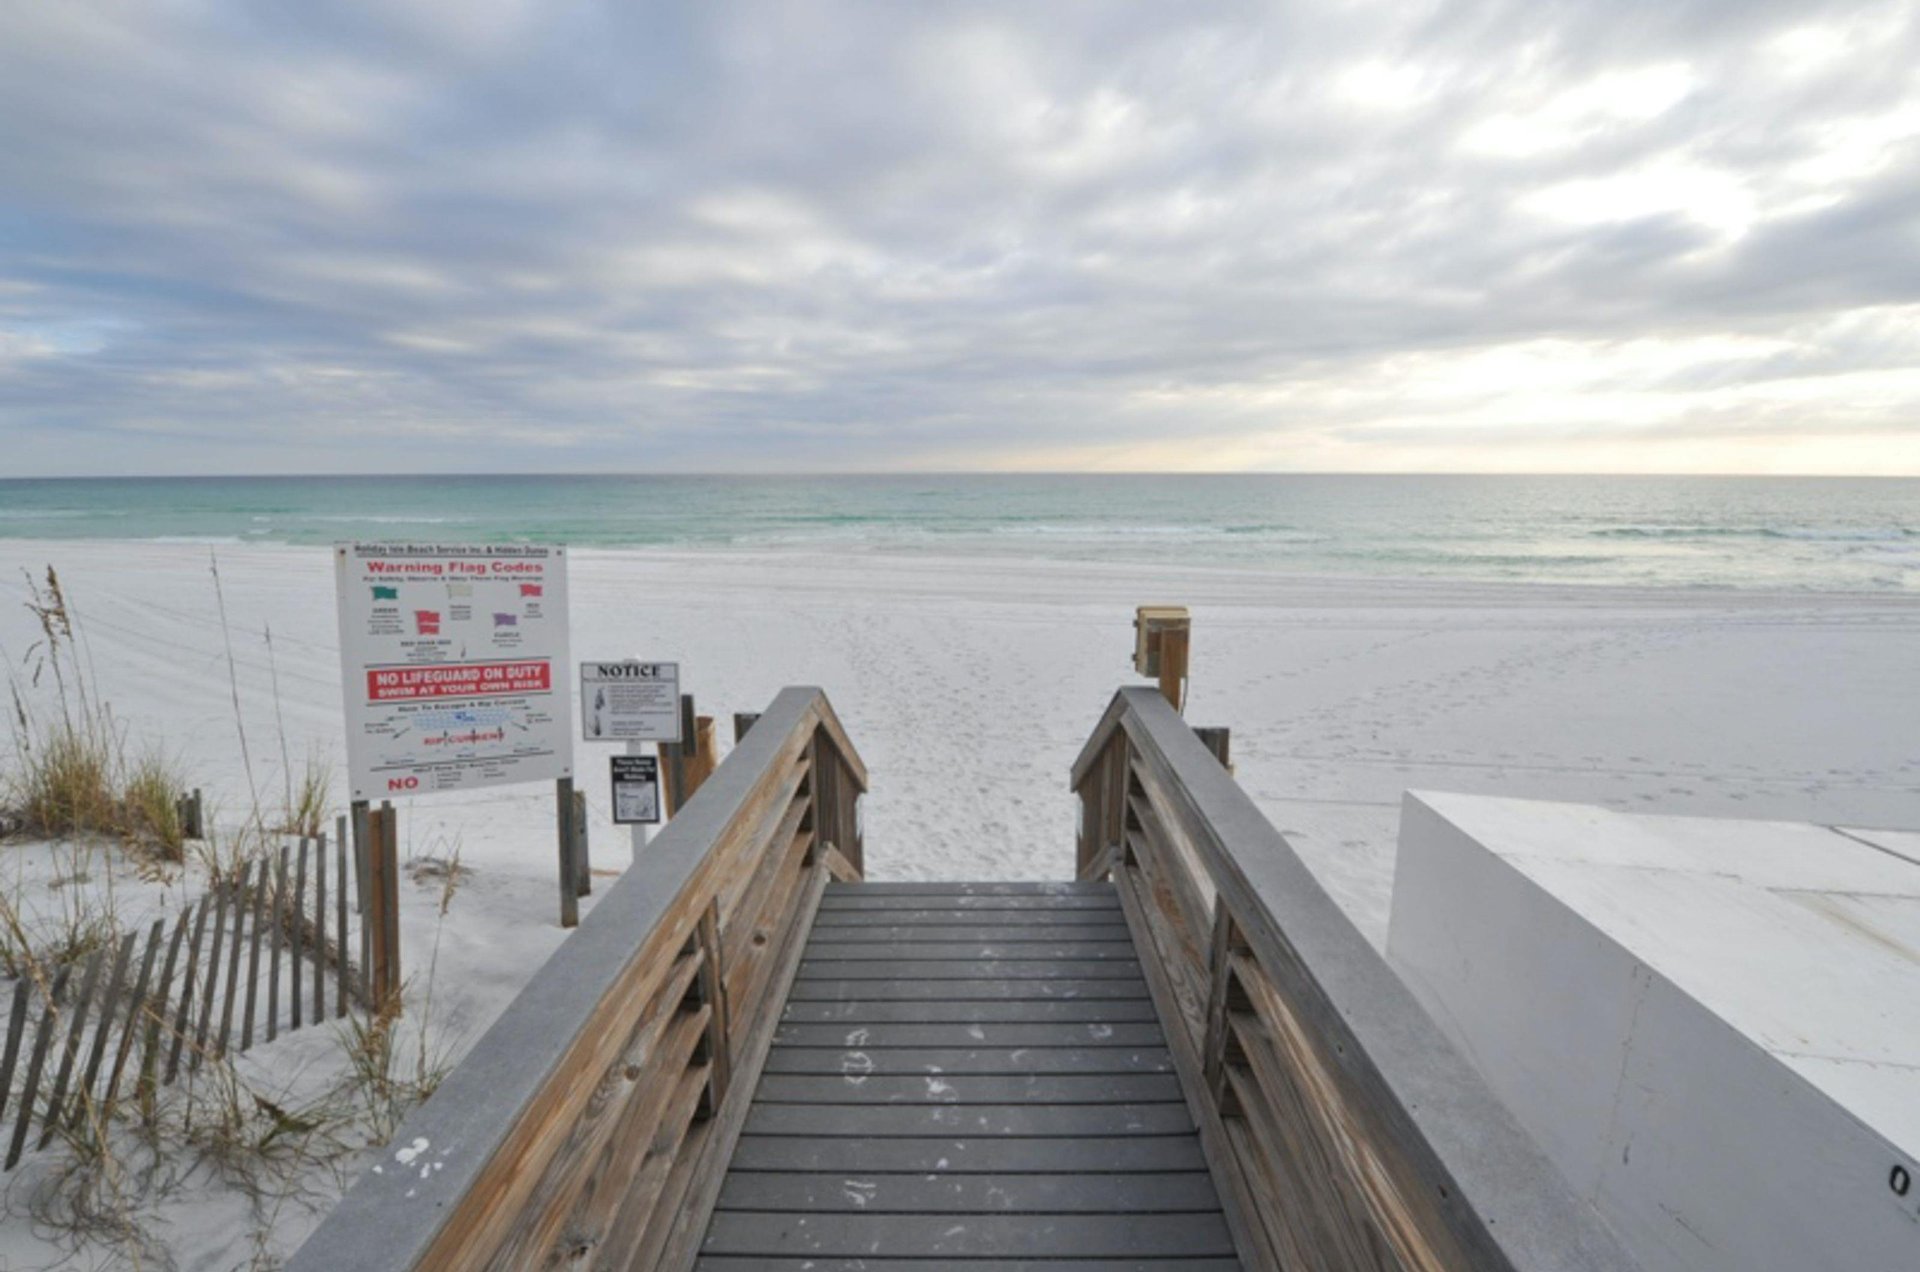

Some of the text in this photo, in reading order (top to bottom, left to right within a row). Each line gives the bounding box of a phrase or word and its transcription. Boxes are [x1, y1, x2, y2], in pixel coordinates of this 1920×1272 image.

[407, 545, 433, 553] Beach
[436, 546, 466, 554] Service
[367, 561, 543, 575] Warning Flag Codes
[376, 664, 542, 686] NO LIFEGUARD ON DUTY
[598, 664, 661, 677] NOTICE
[378, 679, 543, 698] SWIM AT YOUR OWN RISK
[423, 731, 505, 745] RIP CURRENT
[388, 776, 419, 791] NO
